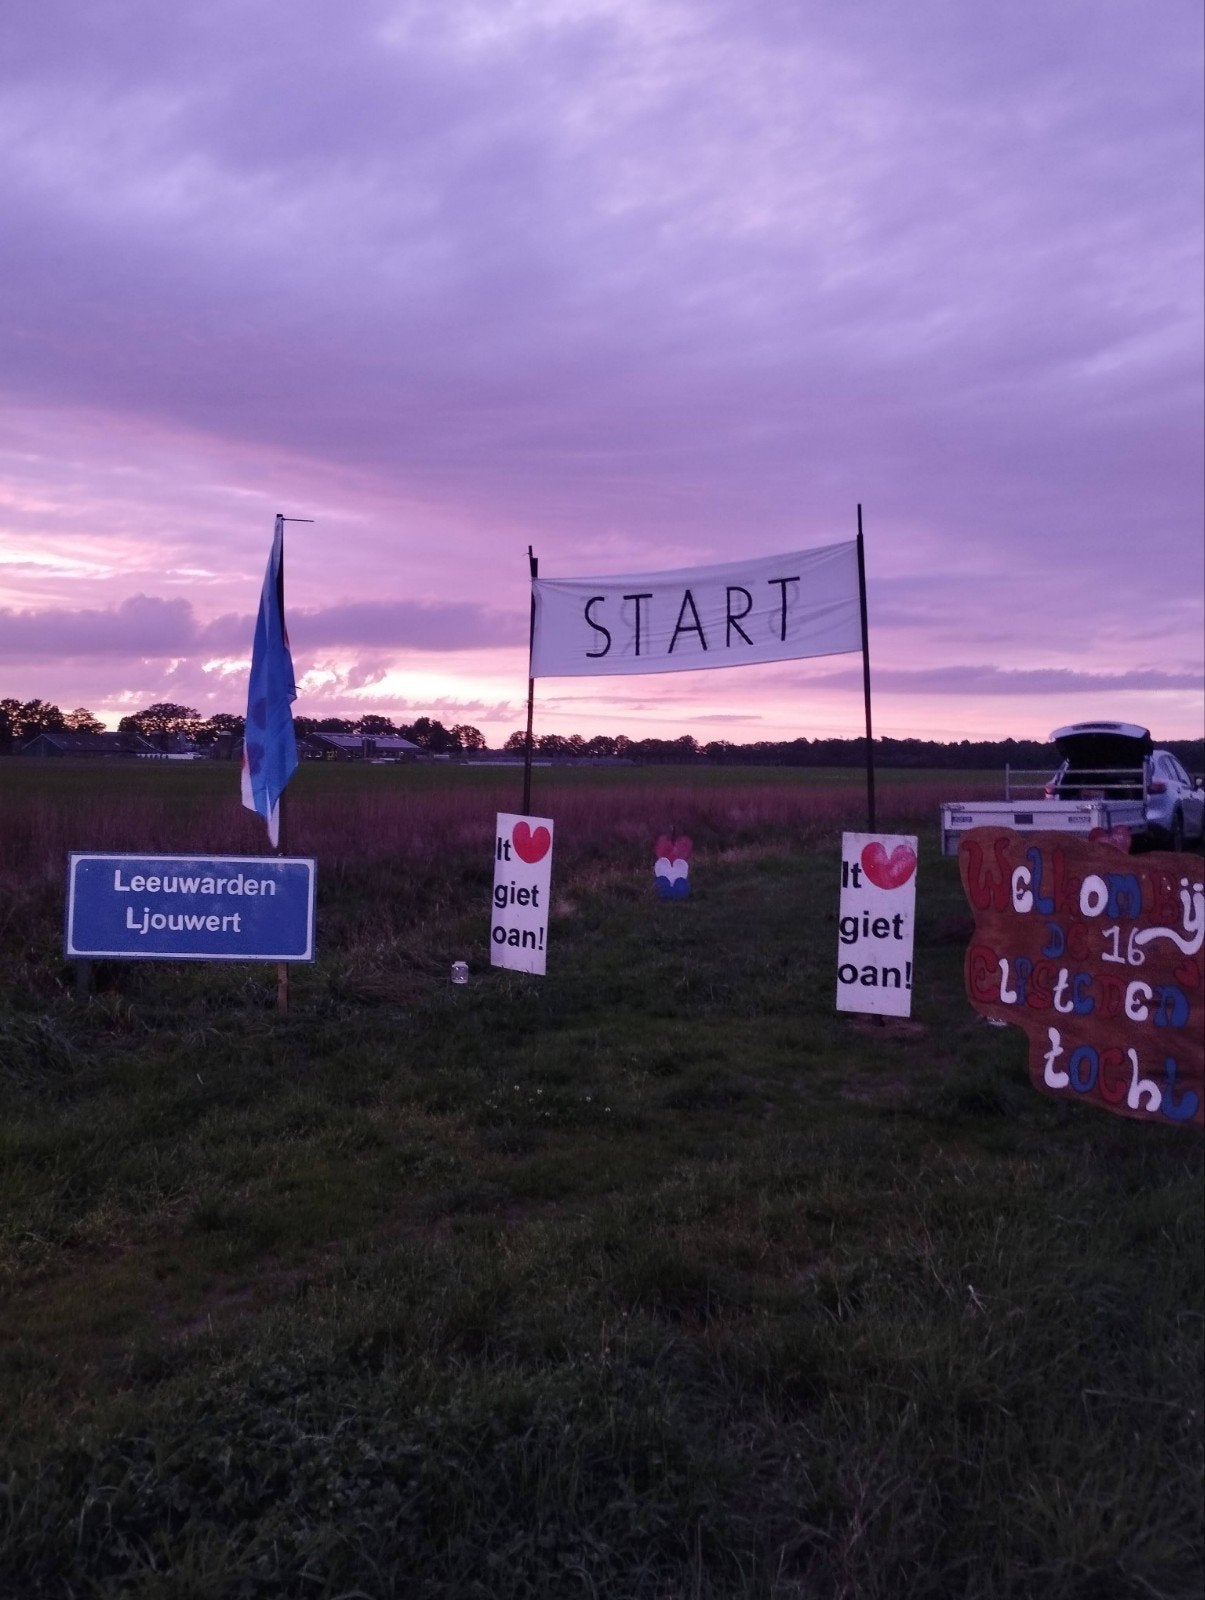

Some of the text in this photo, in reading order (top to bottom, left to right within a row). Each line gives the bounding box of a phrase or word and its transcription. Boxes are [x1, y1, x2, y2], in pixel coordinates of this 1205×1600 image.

[584, 576, 800, 658] START
[496, 837, 511, 861] It
[114, 869, 276, 896] Leeuwarden
[842, 861, 862, 888] It
[494, 881, 539, 908] giet
[126, 906, 241, 934] Ljouwert
[839, 910, 904, 944] giet
[492, 926, 544, 950] oan!
[1101, 925, 1146, 965] 16
[837, 961, 912, 989] oan!
